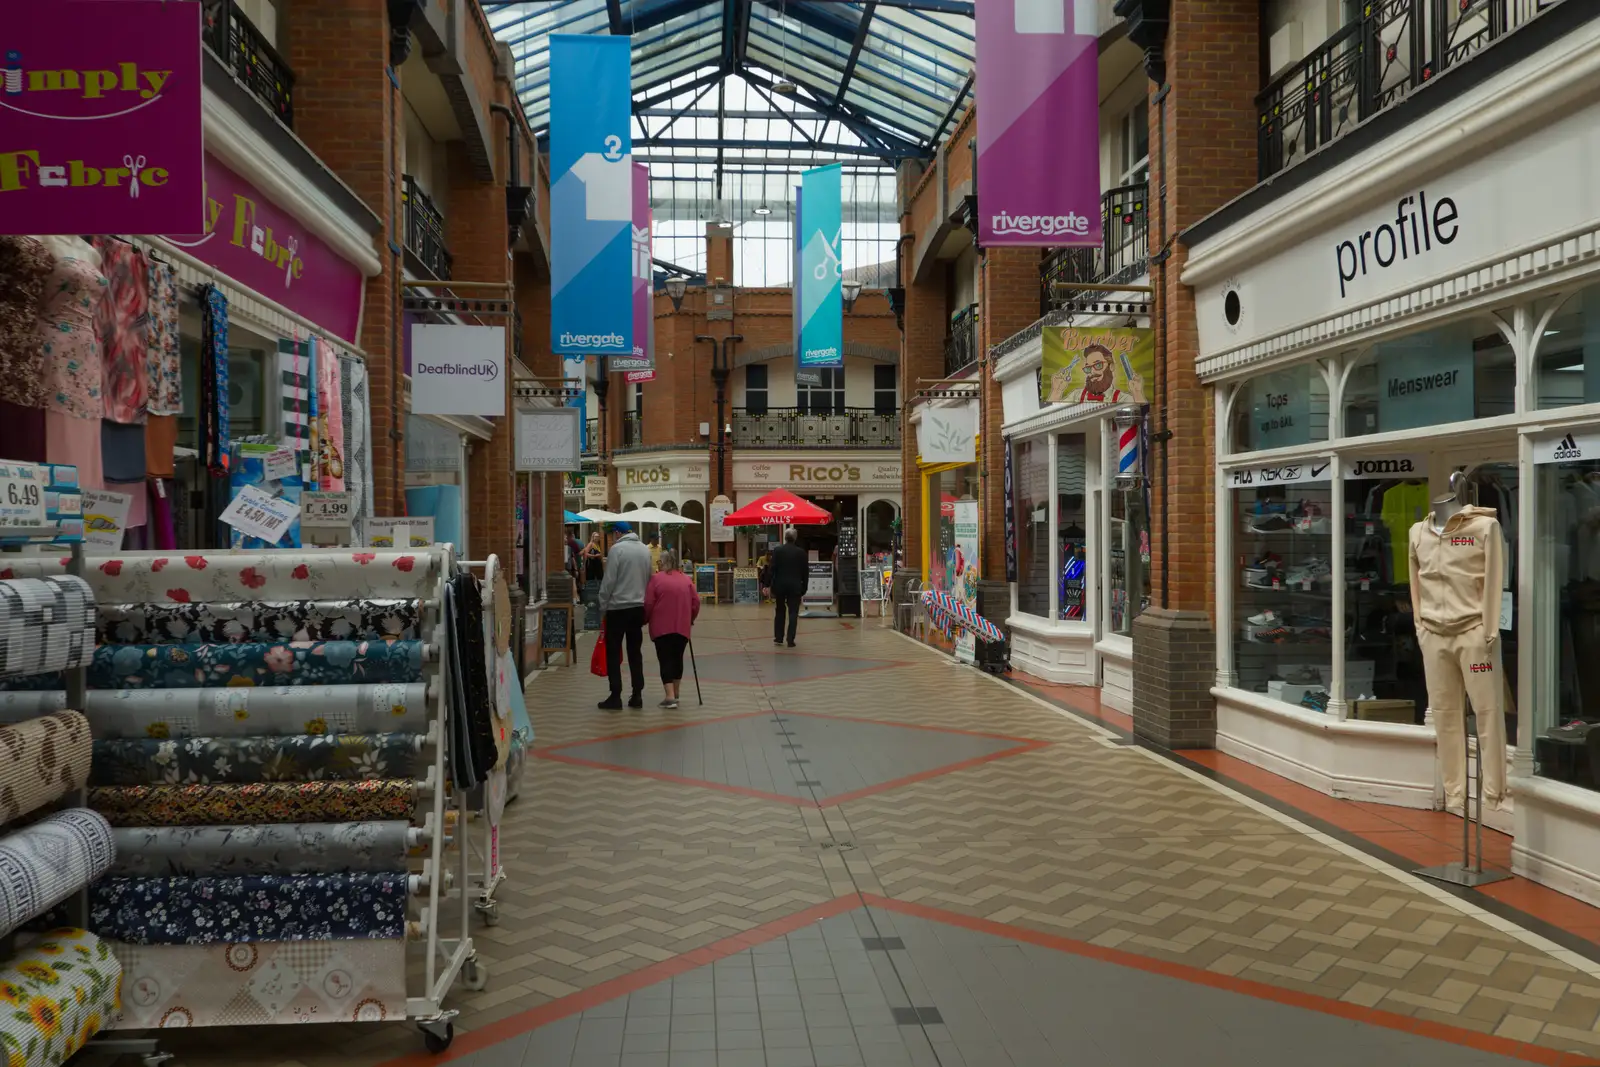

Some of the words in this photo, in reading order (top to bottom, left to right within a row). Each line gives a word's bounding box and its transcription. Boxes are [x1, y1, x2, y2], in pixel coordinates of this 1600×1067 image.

[0, 50, 172, 98] imply
[991, 211, 1089, 235] rivergate
[1336, 191, 1458, 298] profile
[560, 332, 624, 347] rivergate
[1060, 328, 1140, 353] Barber
[805, 347, 837, 358] rivergate
[417, 362, 494, 376] DeafblindUK
[612, 358, 650, 367] rivergate
[1388, 369, 1459, 399] Menswear
[1266, 393, 1288, 410] Tops
[1554, 446, 1581, 460] adidas
[754, 471, 769, 480] Shop
[1233, 469, 1253, 484] FILA
[8, 483, 39, 506] 6.49
[320, 503, 348, 514] 4.99
[761, 516, 792, 524] WALL'S
[1450, 536, 1475, 547] ICON
[1470, 663, 1493, 673] ICON
